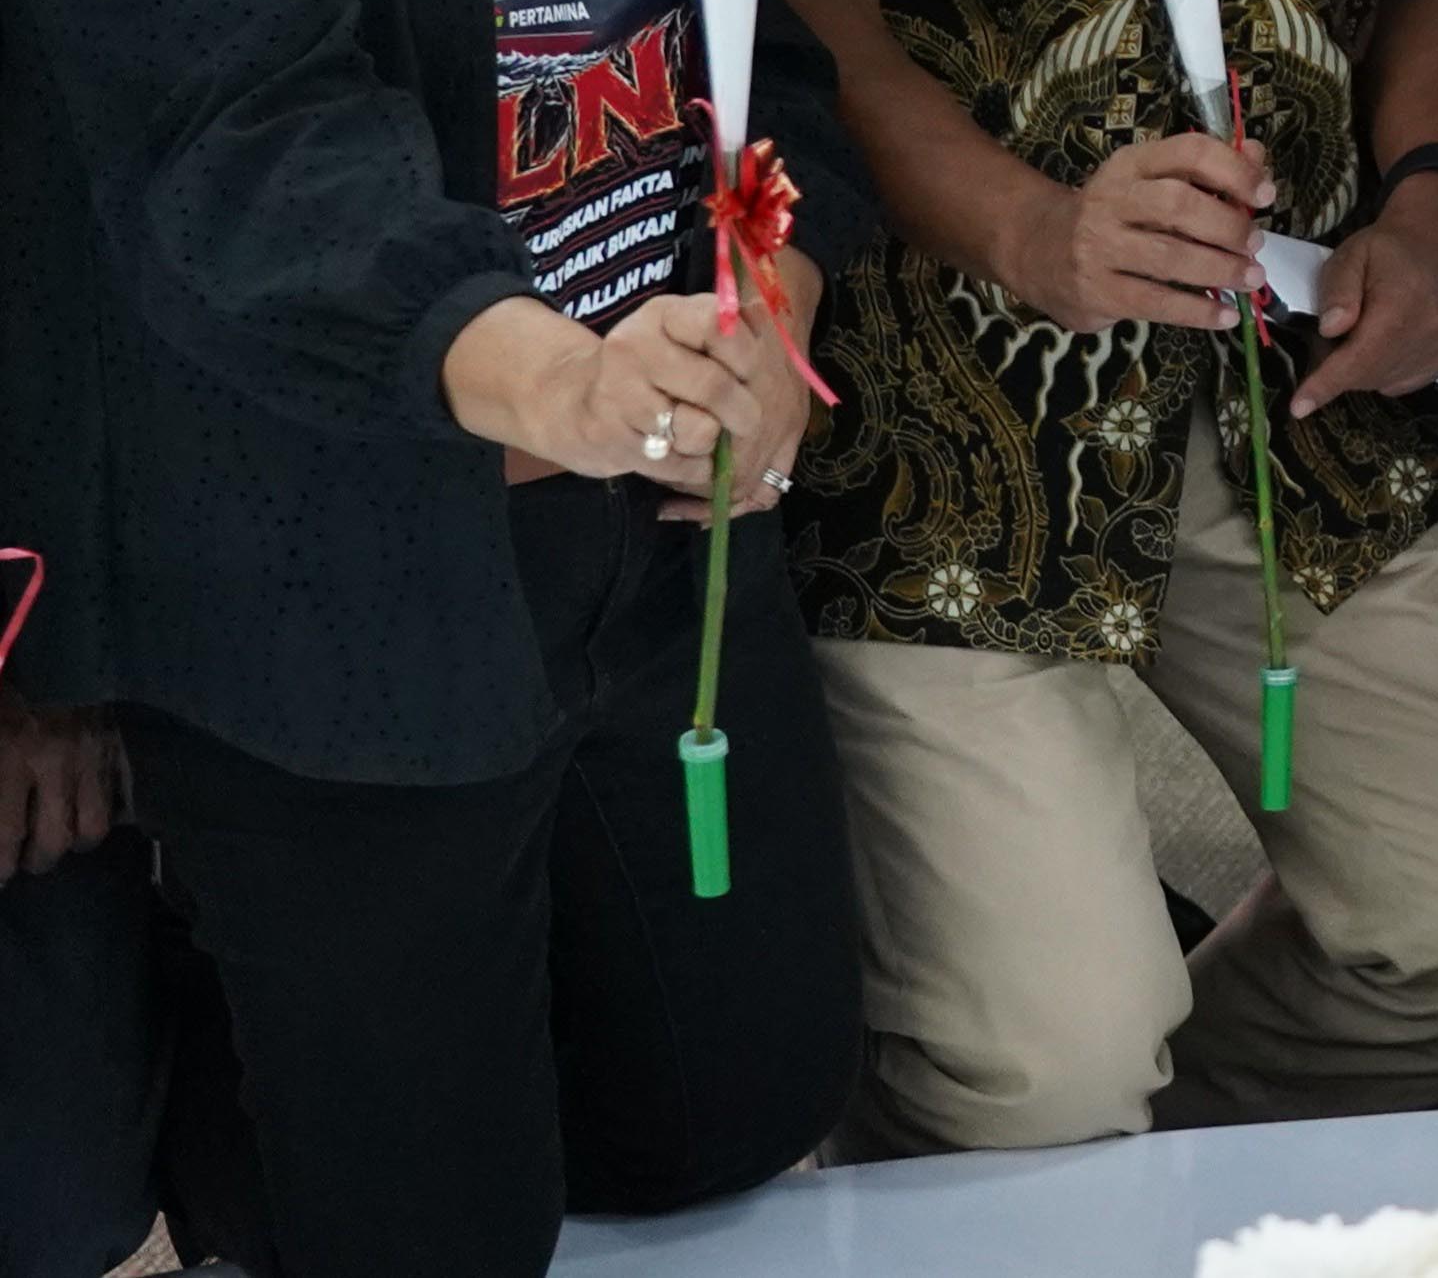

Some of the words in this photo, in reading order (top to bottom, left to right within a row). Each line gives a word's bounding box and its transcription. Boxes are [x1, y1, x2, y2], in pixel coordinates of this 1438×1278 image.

[509, 1, 590, 28] PERTAMINA
[610, 170, 675, 213] FAKTA
[564, 241, 606, 281] BAIK
[606, 210, 677, 259] BUKAN
[574, 267, 641, 319] ALLAH
